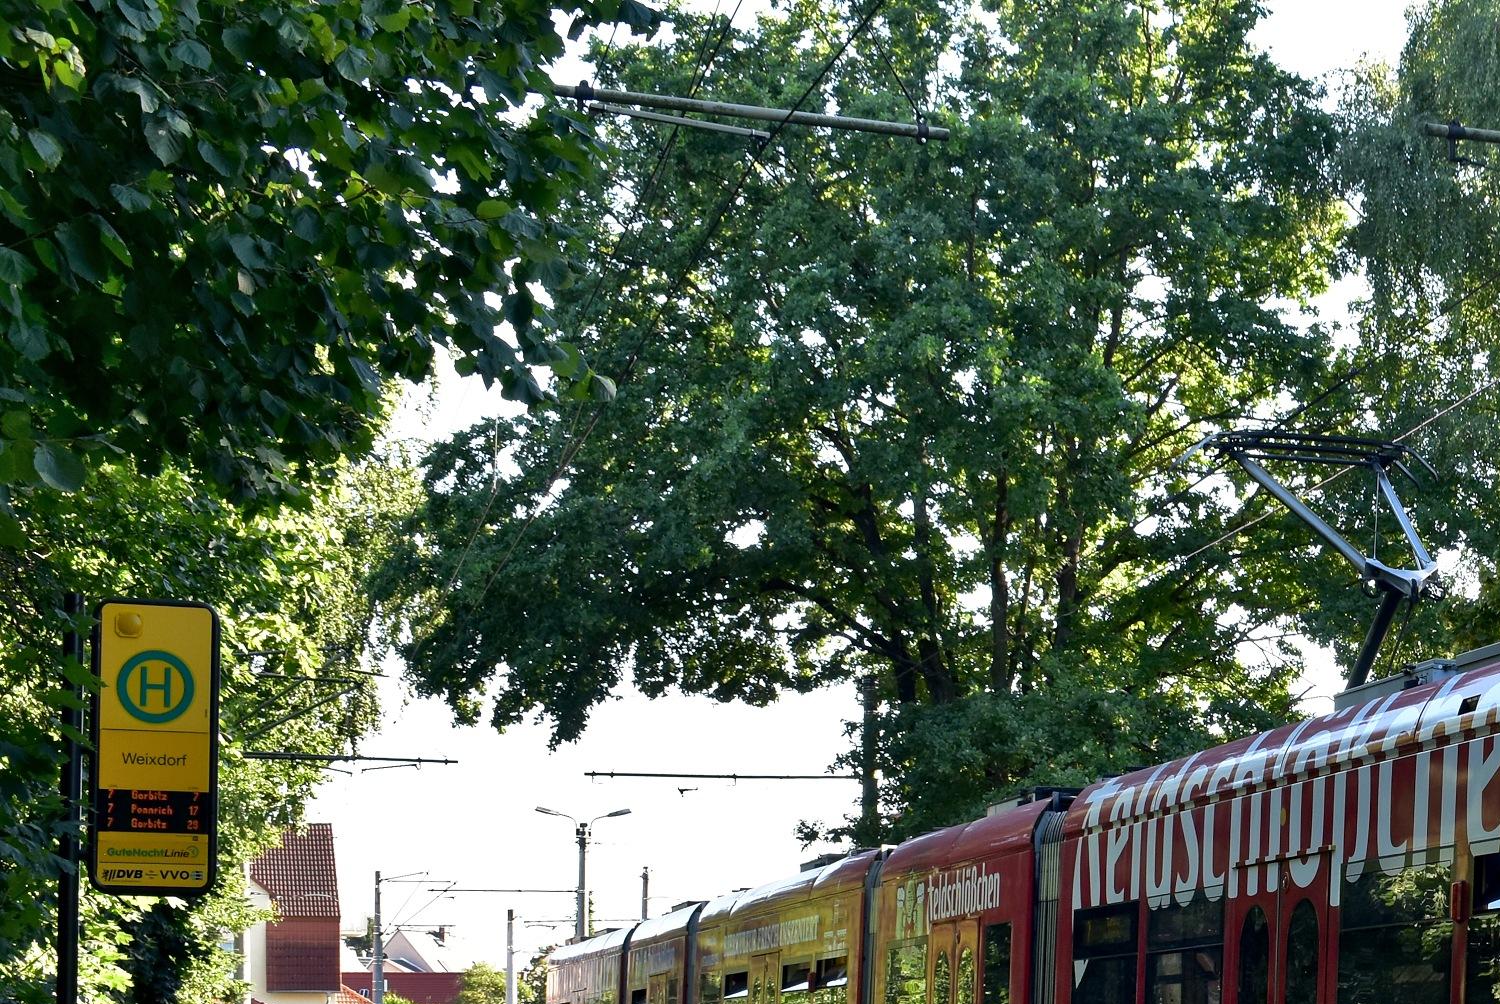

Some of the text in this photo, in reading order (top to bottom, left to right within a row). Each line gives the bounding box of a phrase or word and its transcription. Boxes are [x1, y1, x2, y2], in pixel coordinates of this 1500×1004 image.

[121, 752, 188, 766] Weixdorf
[131, 790, 168, 801] Gorbitz
[107, 803, 114, 813] 7
[188, 805, 199, 816] 17
[107, 817, 113, 828] 7
[131, 817, 168, 829] Gorbitz
[116, 869, 190, 880] DVB VVO
